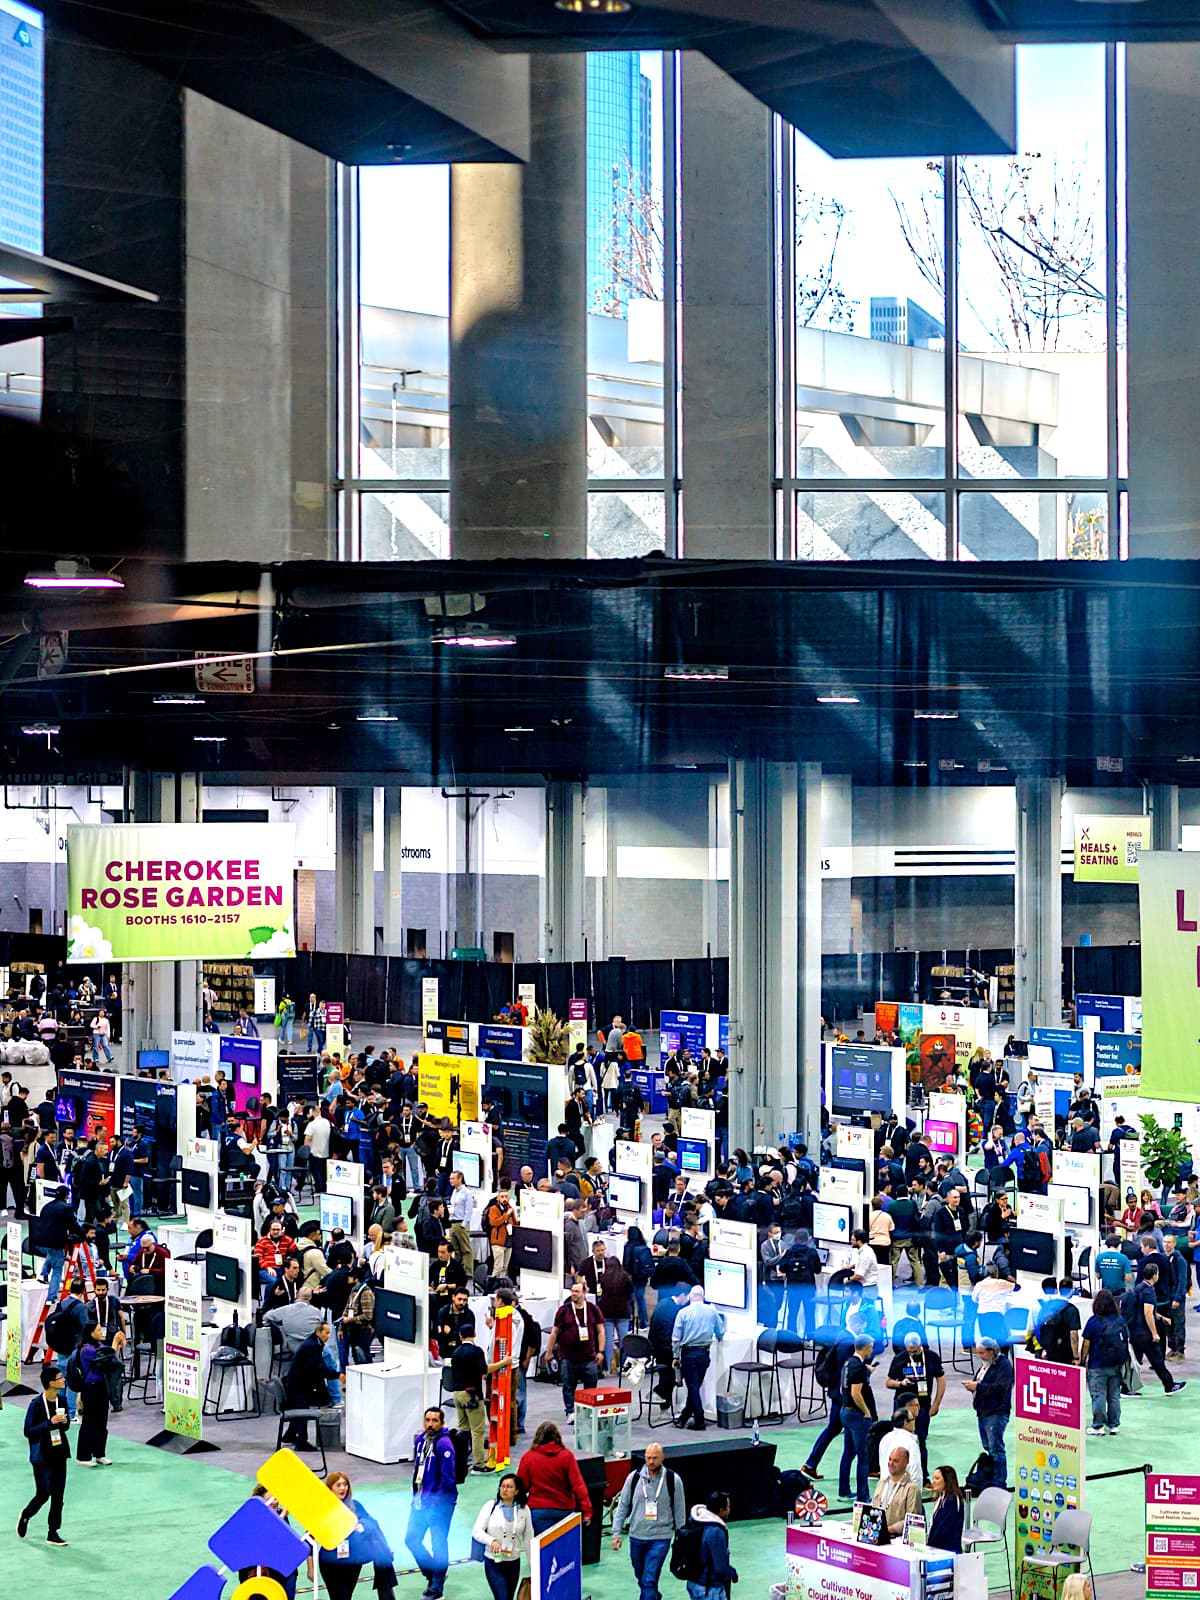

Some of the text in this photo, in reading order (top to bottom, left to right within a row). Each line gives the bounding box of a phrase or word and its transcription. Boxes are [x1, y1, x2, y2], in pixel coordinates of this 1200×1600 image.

[401, 846, 431, 859] strooms
[1080, 843, 1110, 853] MEALS
[1080, 855, 1119, 865] SEATING
[105, 860, 260, 881] CHEROKEE
[81, 886, 283, 909] ROSE GARDEN
[126, 915, 177, 925] BOOTHS
[956, 1041, 972, 1049] ATIVE
[1096, 1043, 1113, 1051] Agentic
[1096, 1061, 1122, 1069] Kubernetes
[1028, 1365, 1050, 1374] WELCOME
[1048, 1393, 1072, 1404] LEARNING
[1048, 1400, 1068, 1409] LOUNGE
[1028, 1426, 1067, 1440] Cultivate Your
[1018, 1433, 1078, 1453] Cloud Native Journey
[830, 1547, 852, 1559] LEARNING
[830, 1553, 848, 1564] LOUNGE
[808, 1588, 829, 1600] Cloud
[821, 1578, 873, 1600] Cultivate Your
